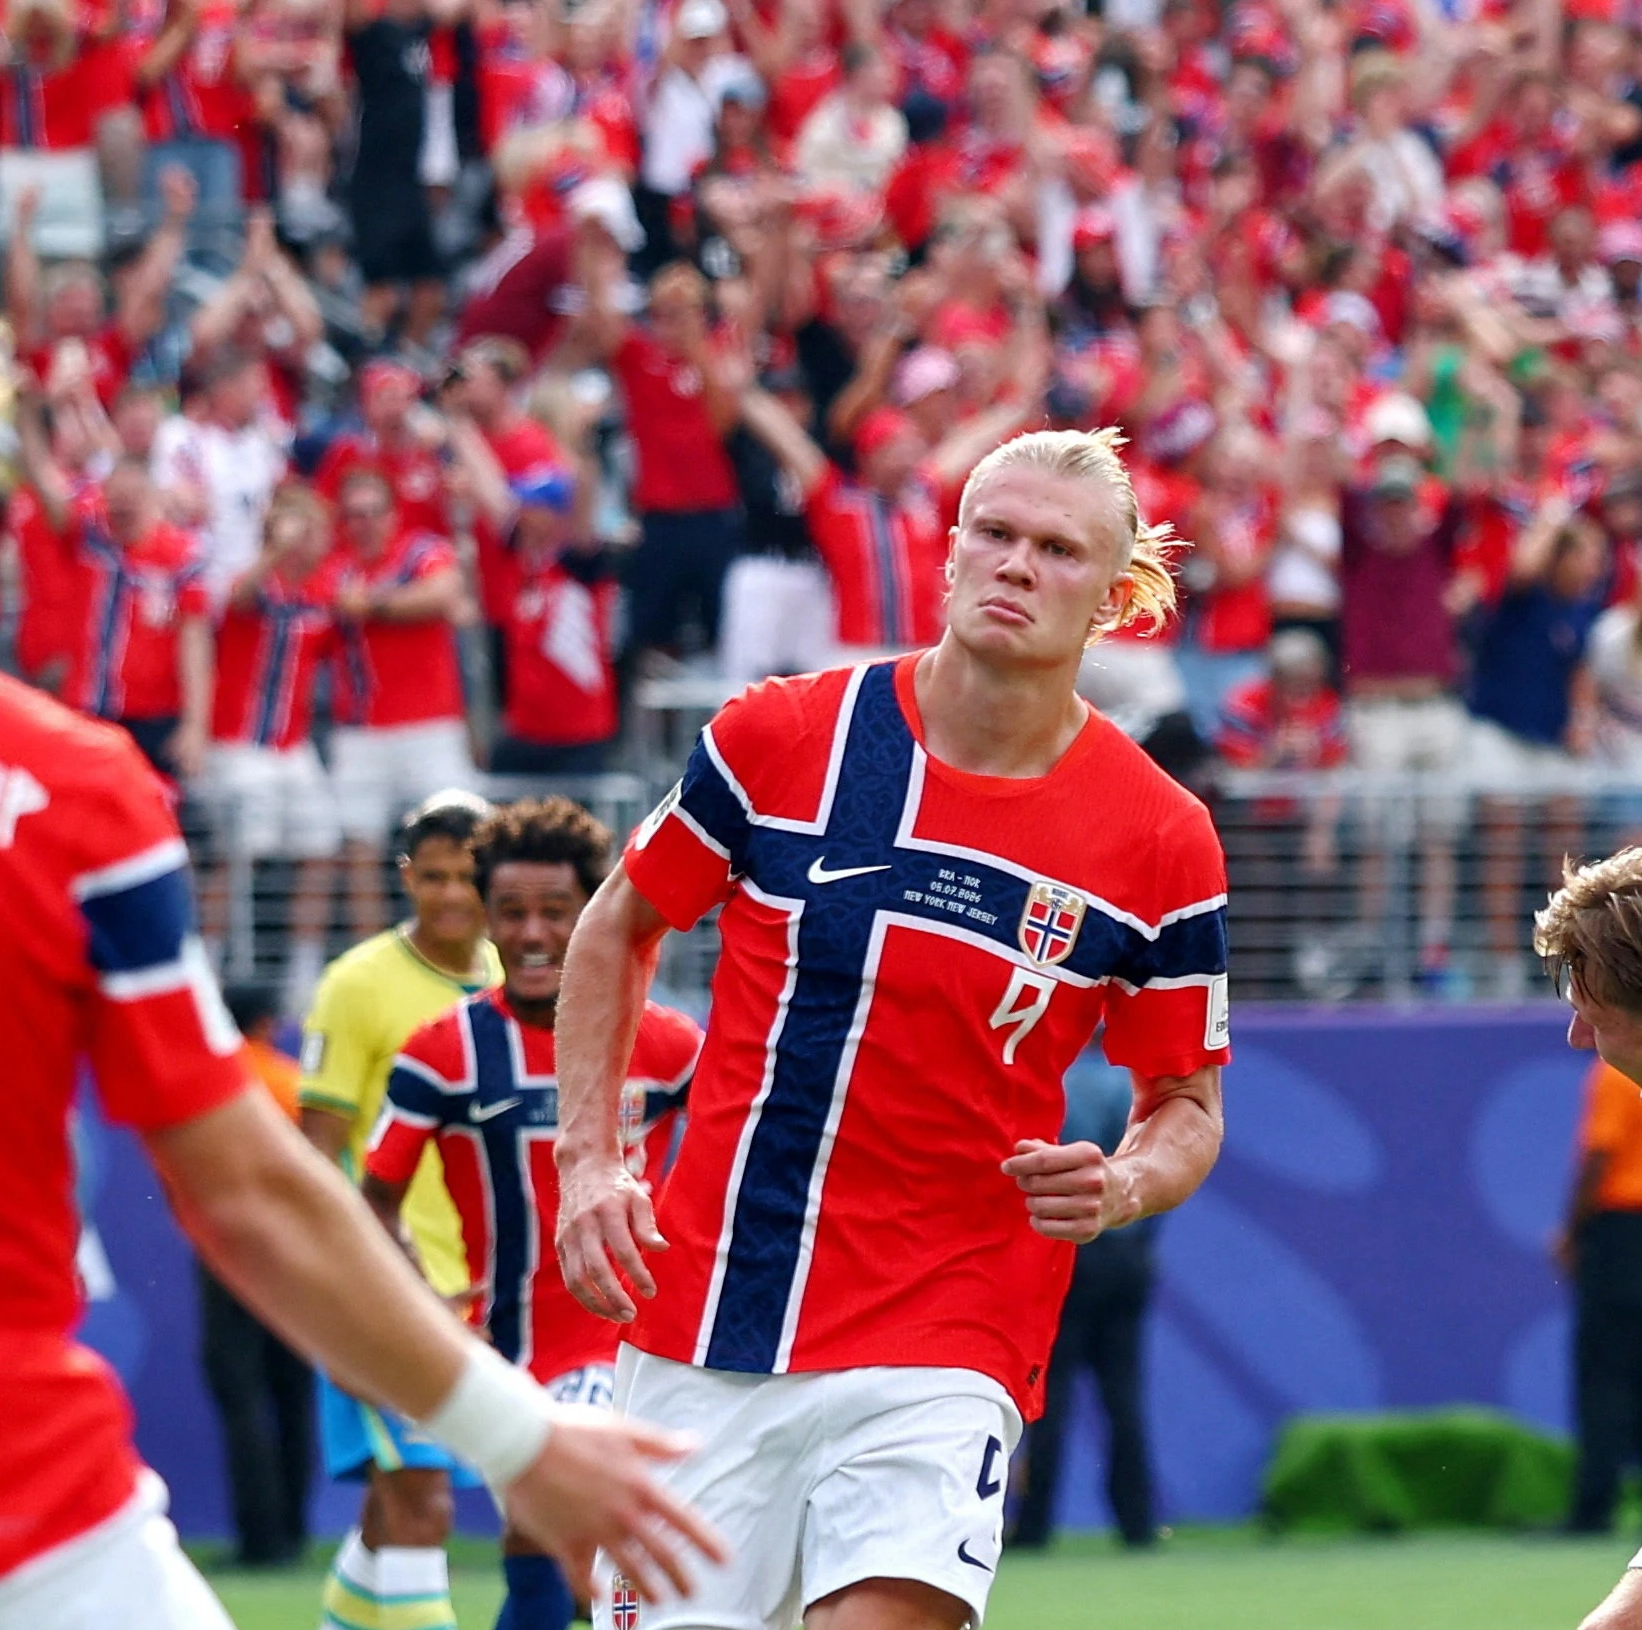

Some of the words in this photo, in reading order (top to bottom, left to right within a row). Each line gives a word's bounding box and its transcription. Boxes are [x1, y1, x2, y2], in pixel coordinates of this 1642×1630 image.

[930, 882, 982, 902] 05.07.2026
[939, 869, 955, 881] BRA
[964, 875, 980, 888] NOR
[904, 890, 922, 902] NEW
[924, 895, 946, 908] YORK
[947, 901, 966, 913] NEW
[967, 908, 997, 925] JERSEY
[988, 966, 1058, 1065] 9
